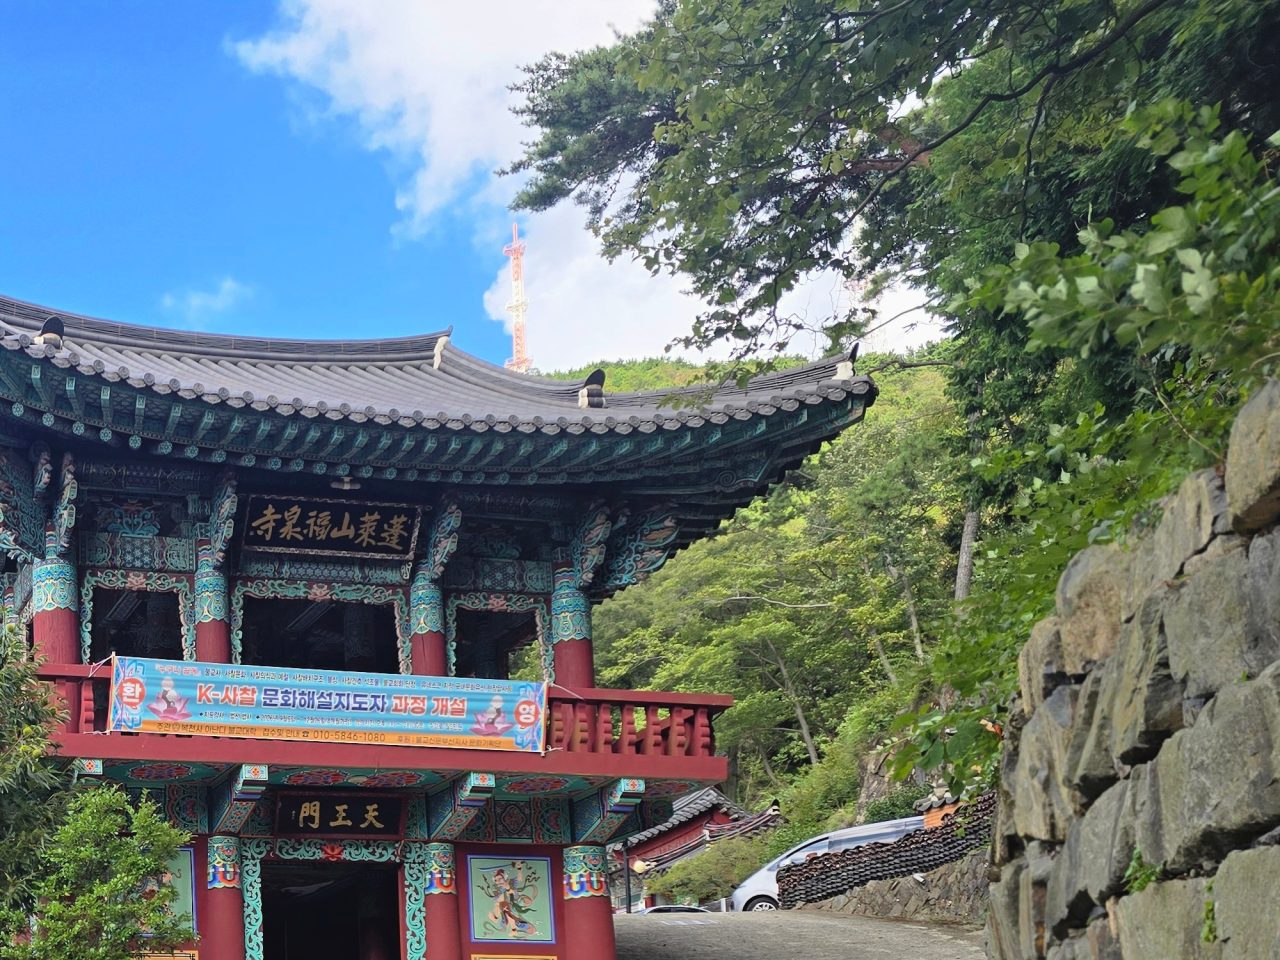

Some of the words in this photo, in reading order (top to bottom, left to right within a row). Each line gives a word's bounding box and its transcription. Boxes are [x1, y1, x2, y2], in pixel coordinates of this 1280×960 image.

[122, 682, 143, 703] 환
[197, 684, 257, 707] K-사찰
[263, 688, 387, 713] 문화해설지도자
[392, 695, 426, 715] 과정
[431, 697, 467, 717] 개설
[518, 704, 536, 723] 영
[312, 730, 385, 741] 010-5846-1080
[299, 801, 384, 828] 天王門
